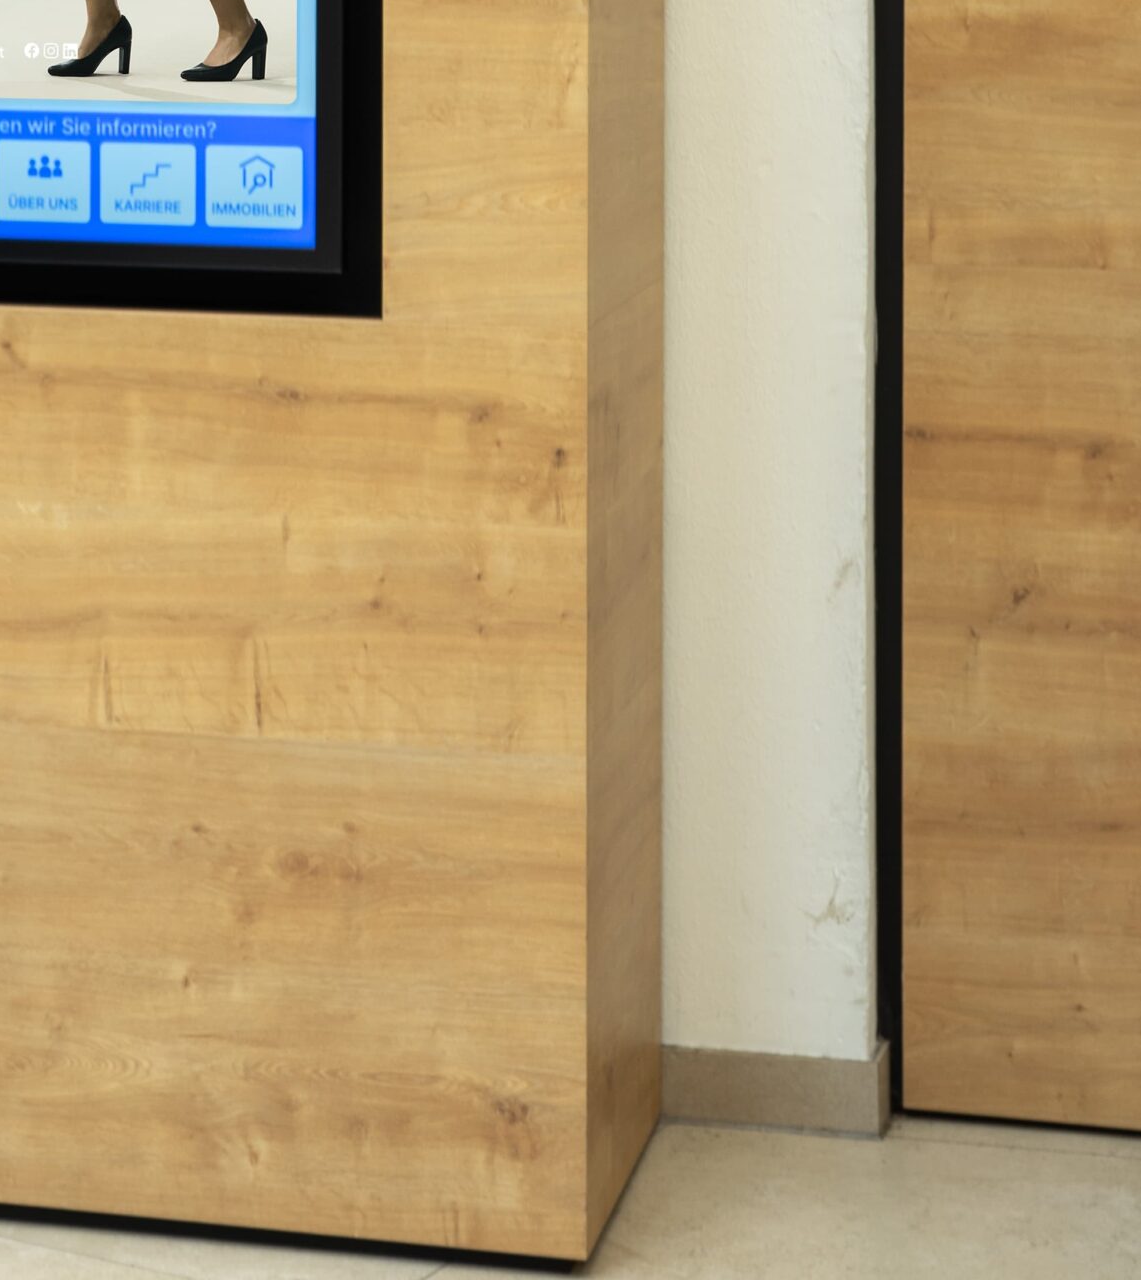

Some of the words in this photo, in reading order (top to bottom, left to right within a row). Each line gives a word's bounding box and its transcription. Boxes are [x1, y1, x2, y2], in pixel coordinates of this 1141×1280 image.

[27, 116, 56, 134] wir
[62, 117, 91, 135] Sie
[96, 118, 217, 138] informieren?
[8, 194, 45, 210] ÜBER
[48, 196, 79, 211] UNS
[114, 198, 182, 215] KARRIERE
[211, 200, 297, 217] IMMOBILIEN
